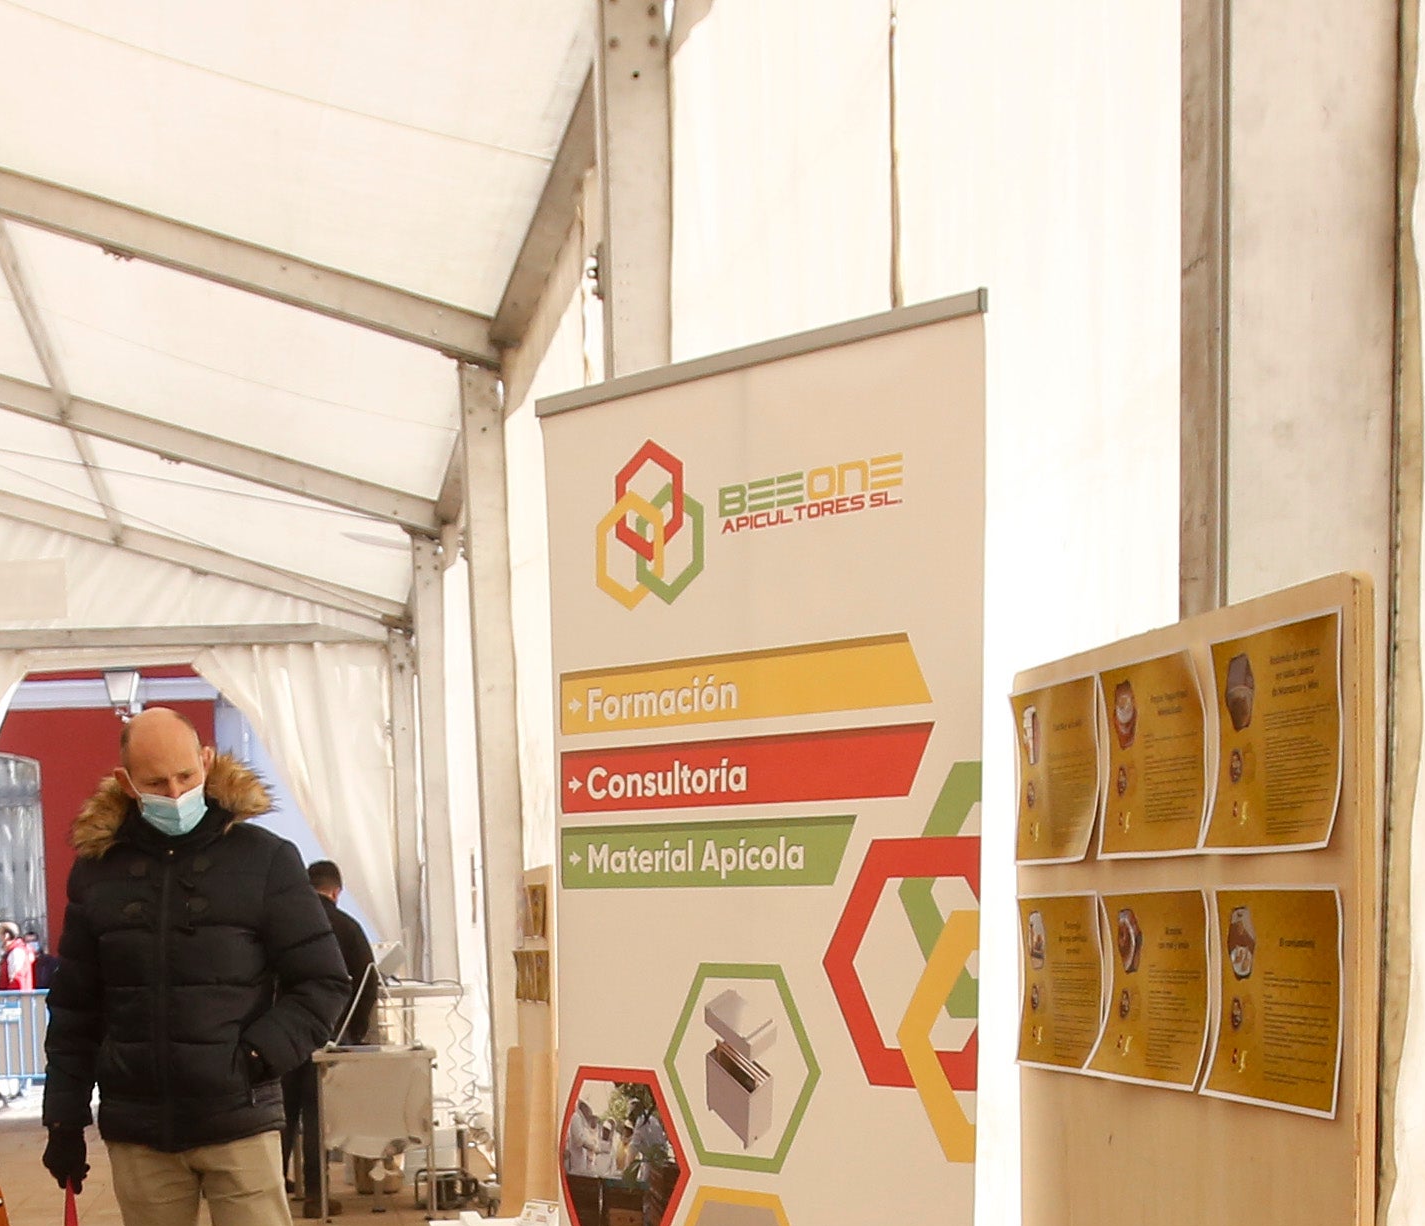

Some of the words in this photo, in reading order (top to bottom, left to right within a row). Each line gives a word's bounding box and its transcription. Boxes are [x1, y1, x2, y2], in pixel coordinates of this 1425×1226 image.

[718, 452, 903, 518] BEEONE
[721, 494, 866, 534] APICULTORES
[870, 491, 903, 508] SL.
[586, 674, 738, 722] Formación
[586, 758, 748, 799] Consultoría
[587, 840, 693, 874] Material
[701, 838, 805, 879] Apícola
